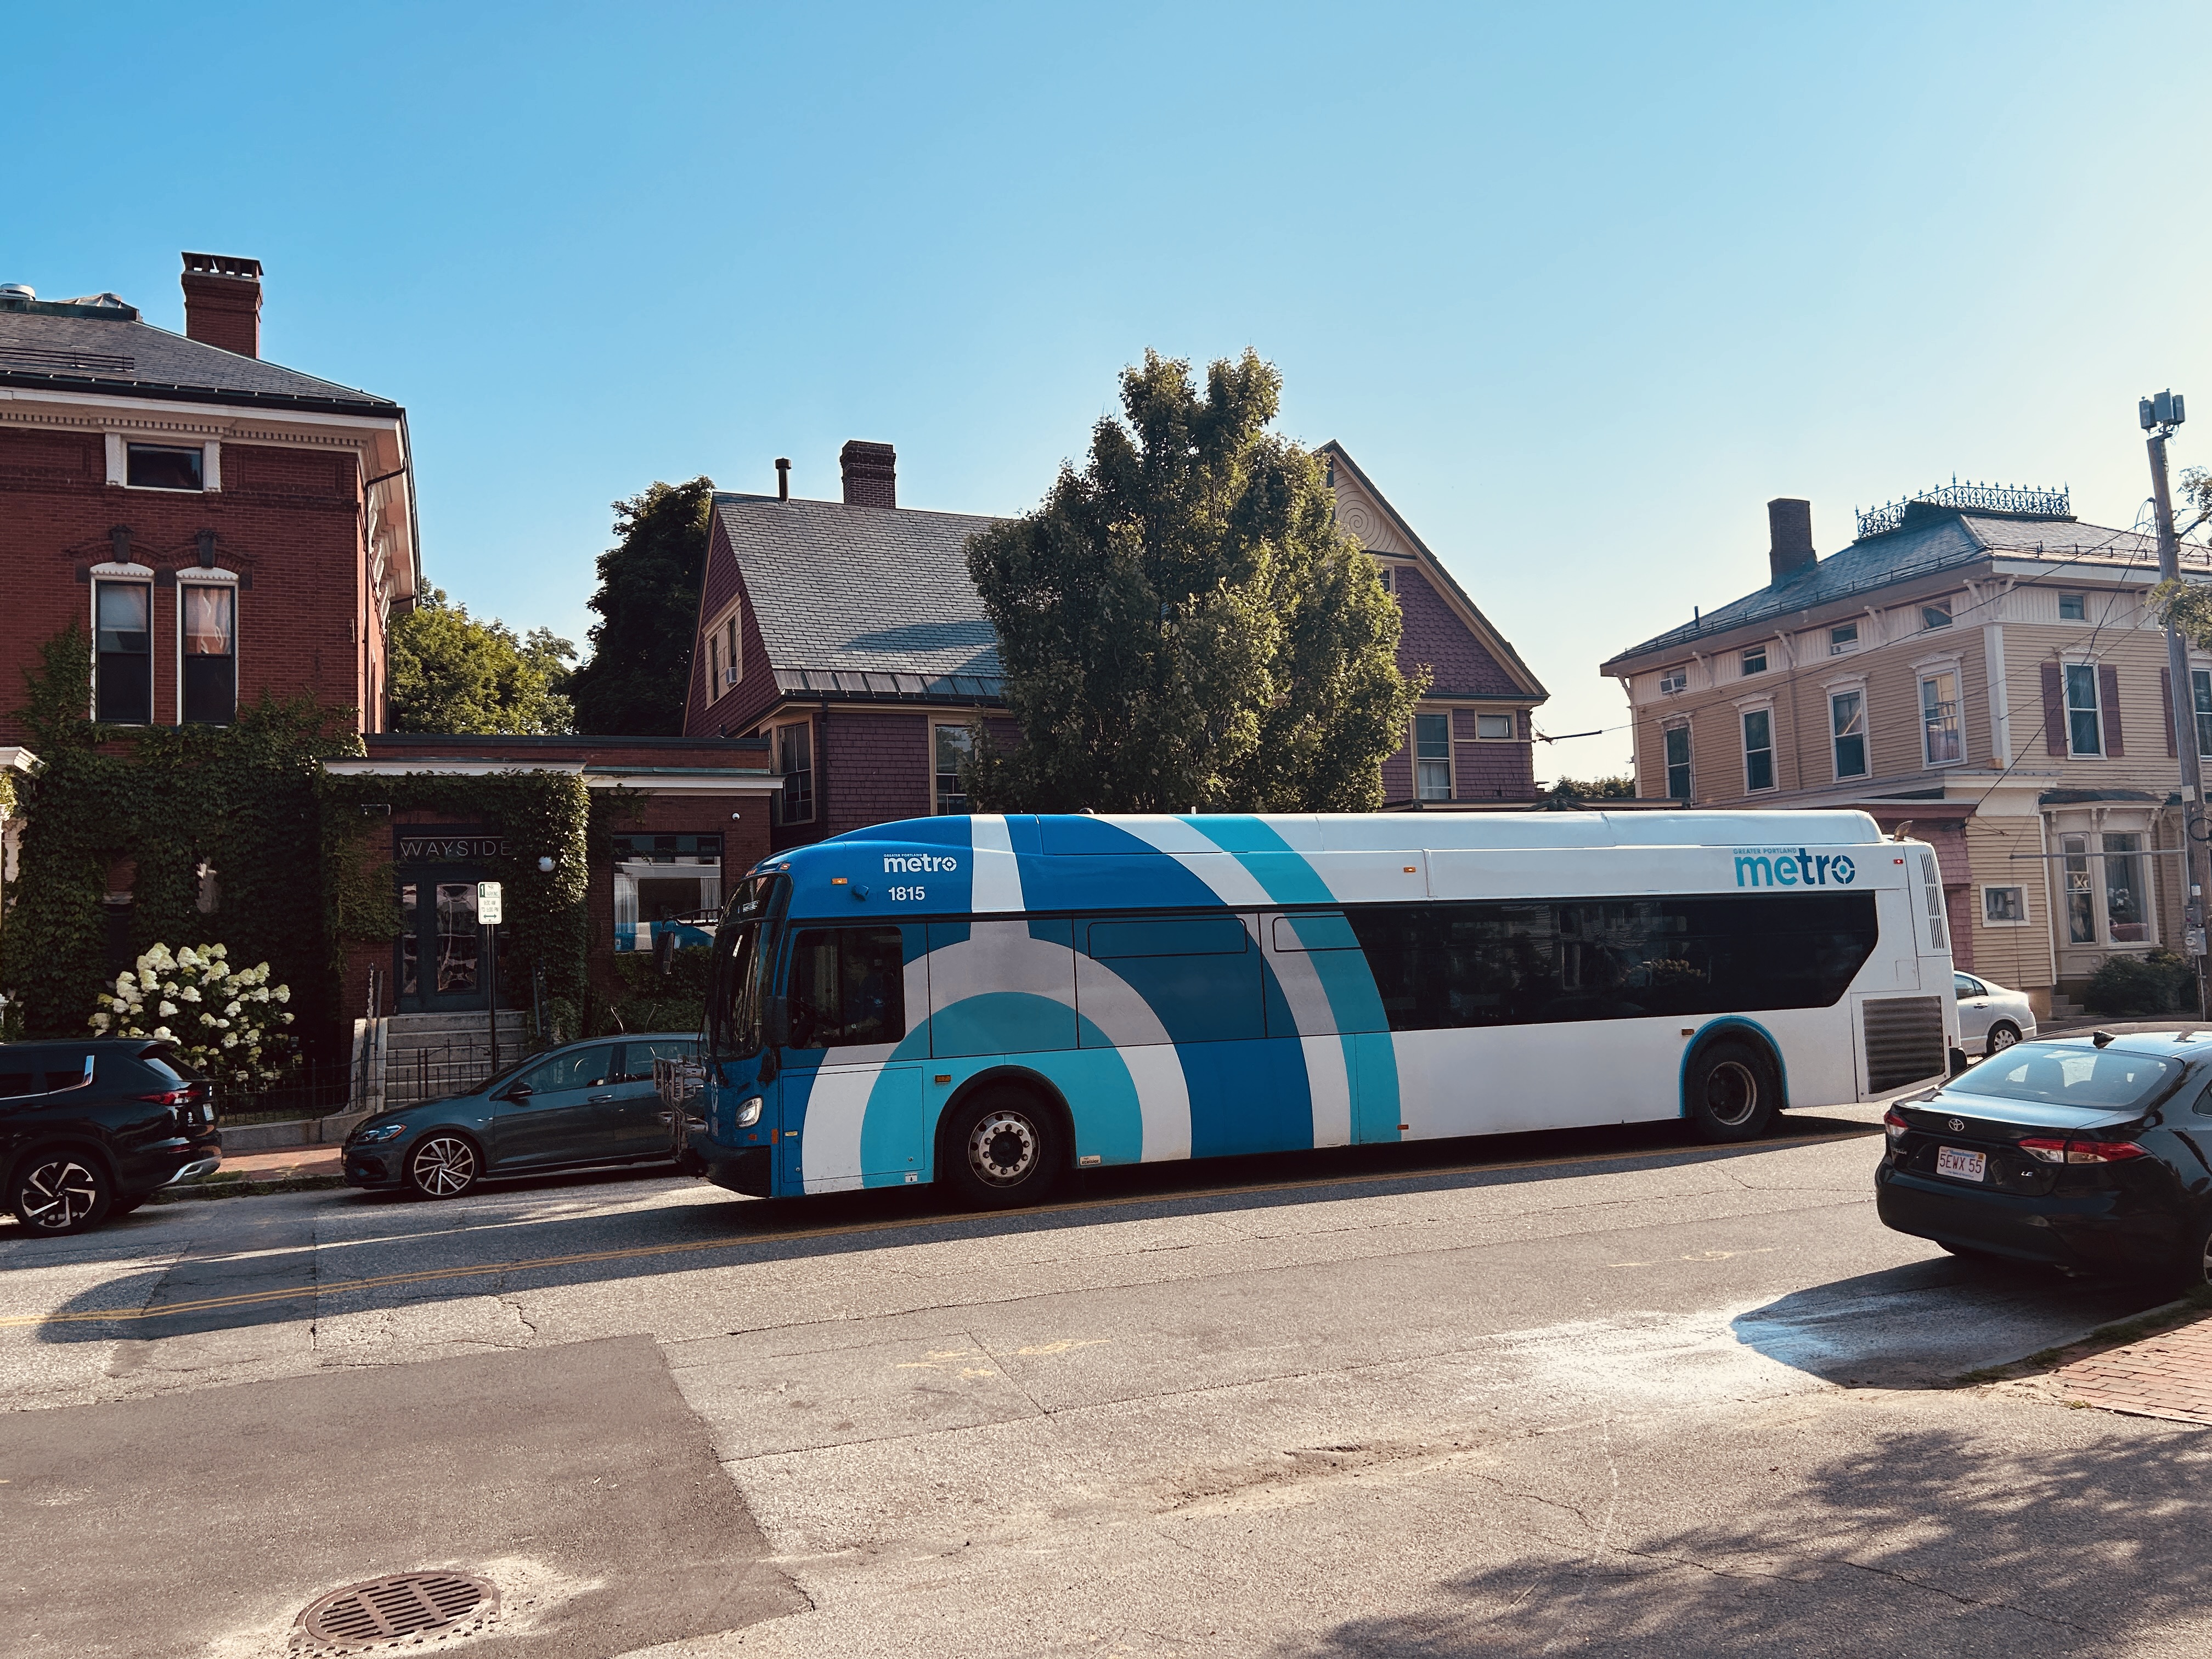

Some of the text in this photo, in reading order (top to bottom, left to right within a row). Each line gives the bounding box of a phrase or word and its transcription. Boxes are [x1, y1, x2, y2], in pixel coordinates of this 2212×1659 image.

[400, 840, 512, 857] WAYSIDE
[884, 853, 957, 873] metro
[1734, 848, 1855, 887] metro
[481, 884, 484, 895] 1
[888, 886, 926, 901] 1815
[1939, 1153, 1966, 1171] 5EWX
[1968, 1158, 1983, 1173] 55
